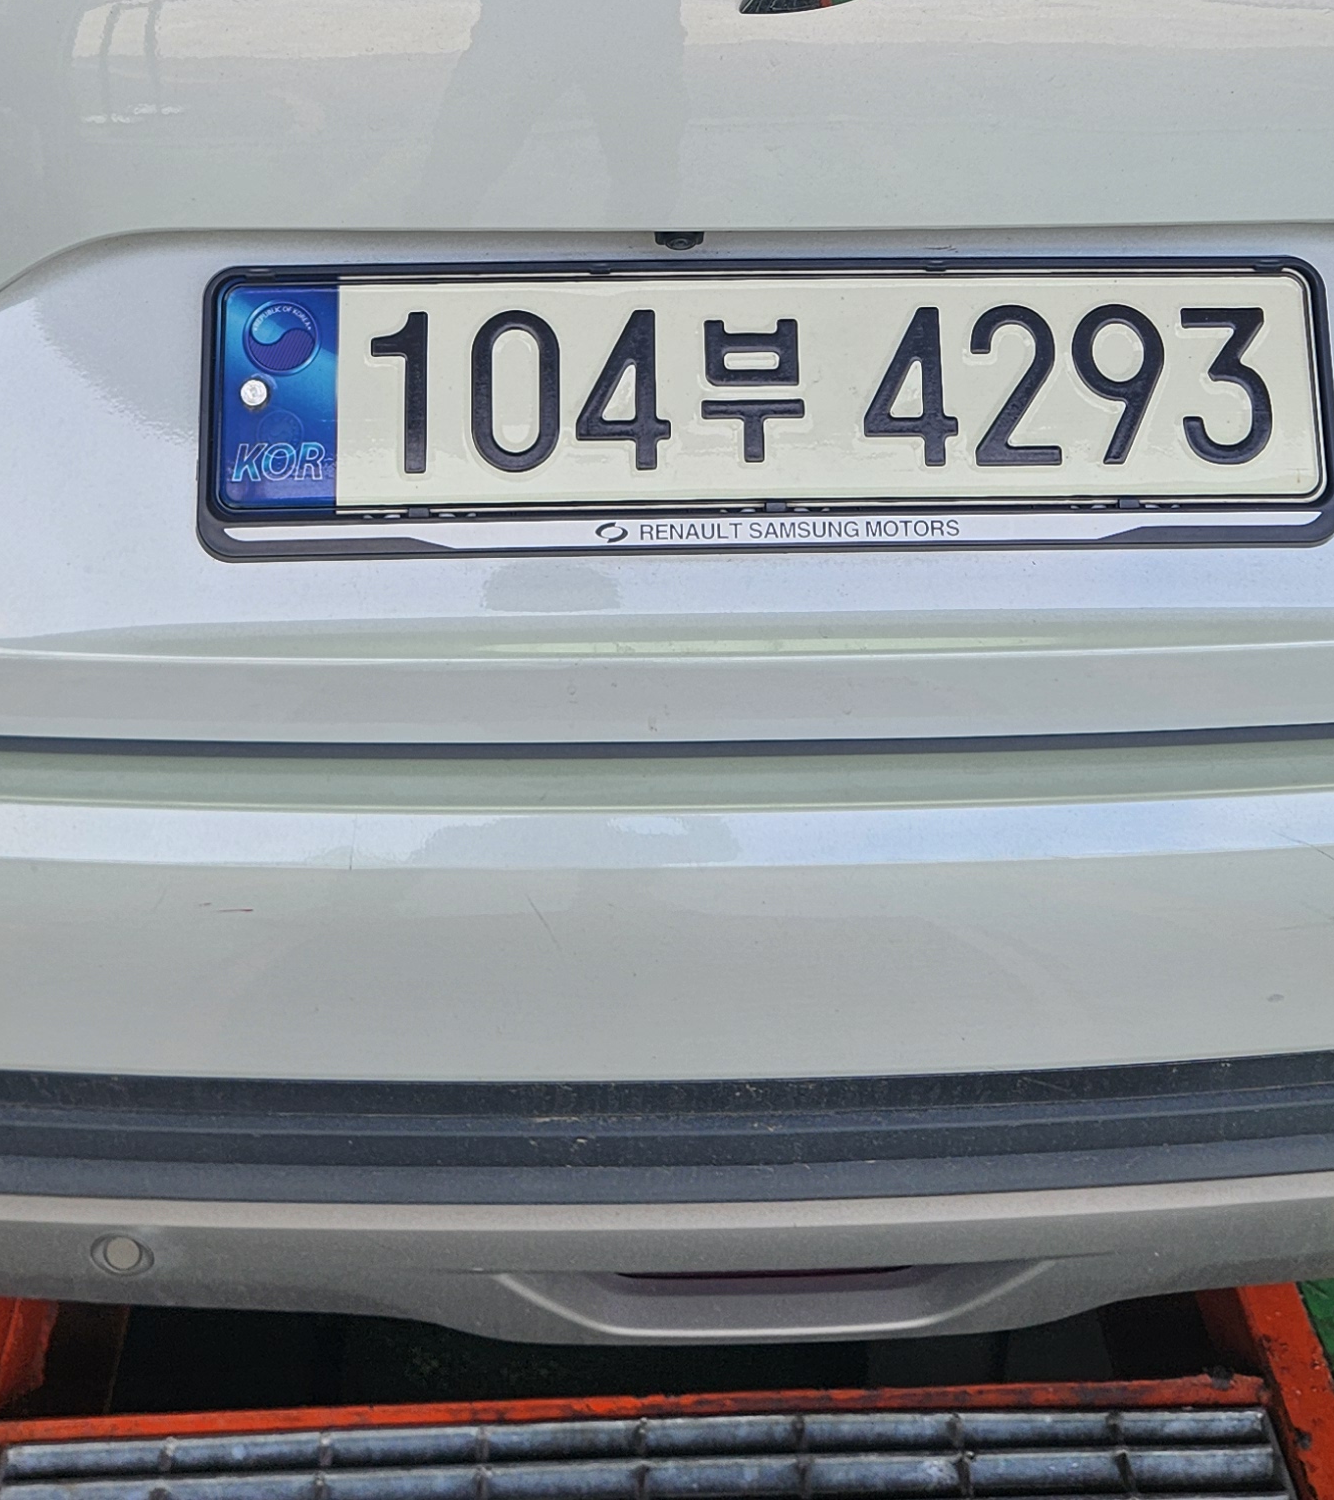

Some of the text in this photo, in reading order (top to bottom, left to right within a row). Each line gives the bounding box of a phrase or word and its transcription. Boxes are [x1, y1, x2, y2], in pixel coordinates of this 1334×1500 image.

[369, 303, 1273, 474] 104부 4293
[231, 441, 327, 482] KOR
[639, 519, 961, 541] RENAULT SAMSUNG MOTORS
